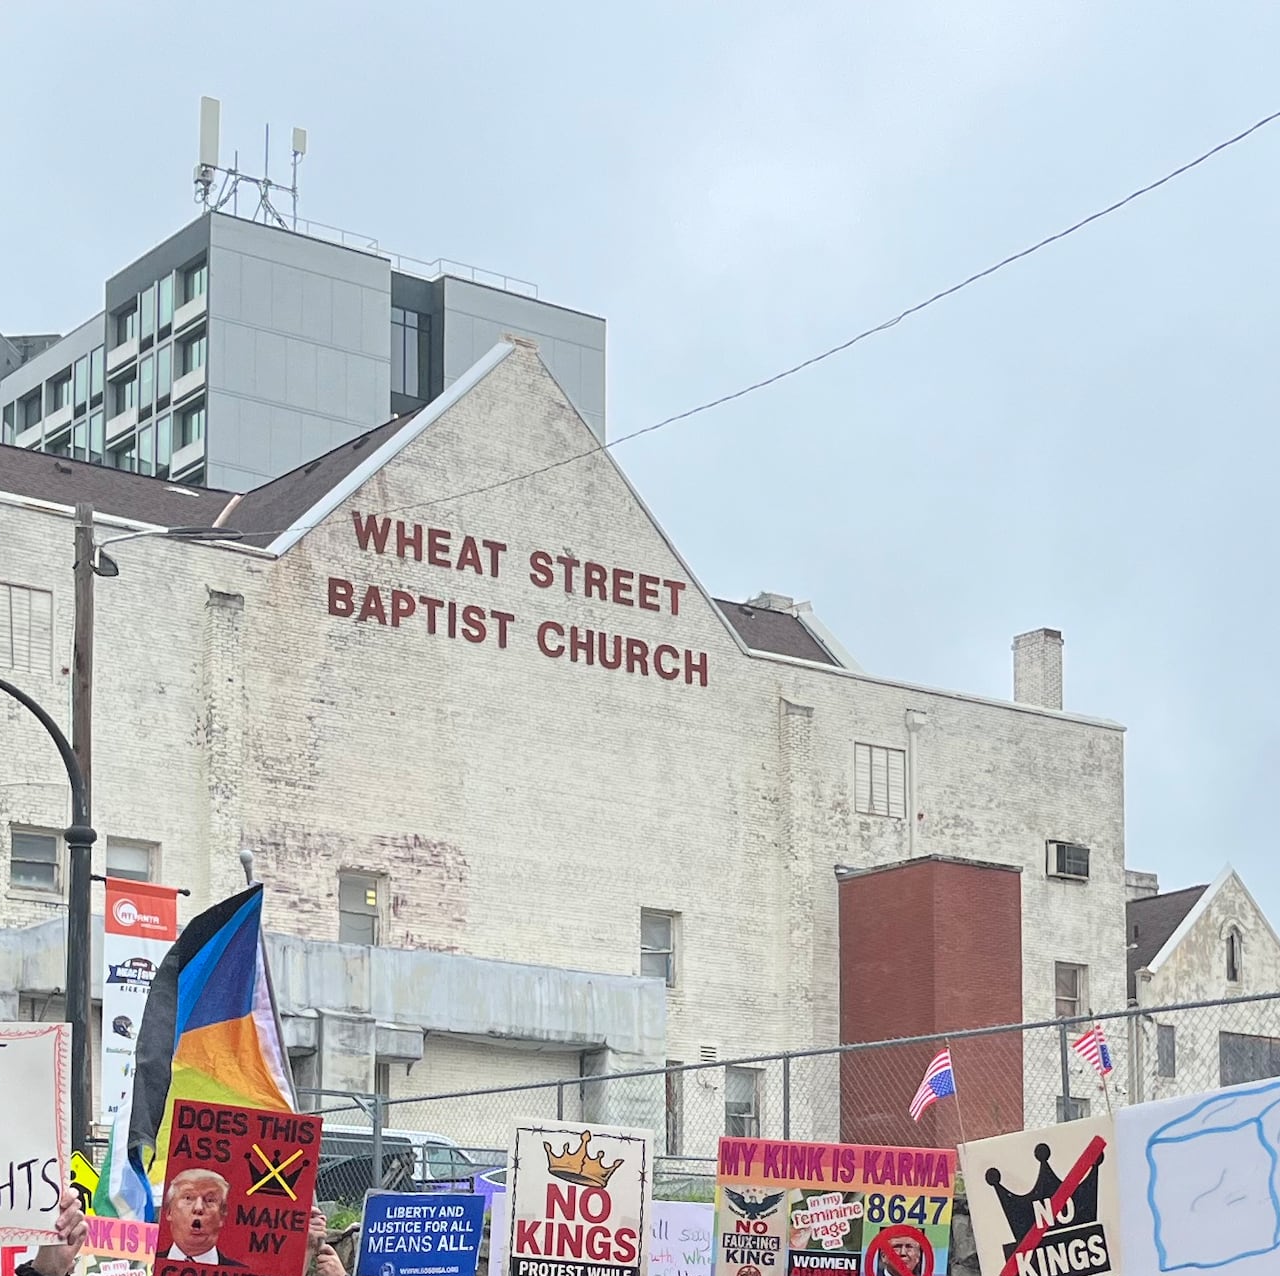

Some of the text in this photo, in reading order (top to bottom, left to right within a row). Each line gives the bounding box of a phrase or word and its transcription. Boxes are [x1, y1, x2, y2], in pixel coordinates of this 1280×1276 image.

[352, 511, 686, 616] WHEAT STREET
[328, 577, 708, 687] BAPTIST CHURCH
[121, 911, 160, 924] ATLANTA
[178, 1105, 315, 1144] DOES THIS
[173, 1135, 232, 1163] ASS
[720, 1141, 950, 1188] MY KINK IS KARMA
[386, 1206, 464, 1219] LIBERTY AND
[546, 1183, 611, 1224] NO
[810, 1195, 841, 1208] in my
[867, 1193, 948, 1225] 8647
[235, 1205, 306, 1232] MAKE
[794, 1203, 861, 1226] feminine
[1033, 1197, 1075, 1229] NO
[120, 1223, 139, 1253] IS
[368, 1221, 473, 1233] JUSTICE FOR ALL
[735, 1220, 768, 1234] NO
[814, 1222, 848, 1240] rage
[249, 1232, 287, 1254] MY
[368, 1234, 474, 1253] MEANS ALL.
[516, 1219, 637, 1263] KINGS
[723, 1235, 779, 1250] FAUX-ING
[825, 1239, 840, 1249] era
[102, 1261, 127, 1272] in my
[726, 1250, 775, 1266] KING
[793, 1255, 857, 1270] WOMEN
